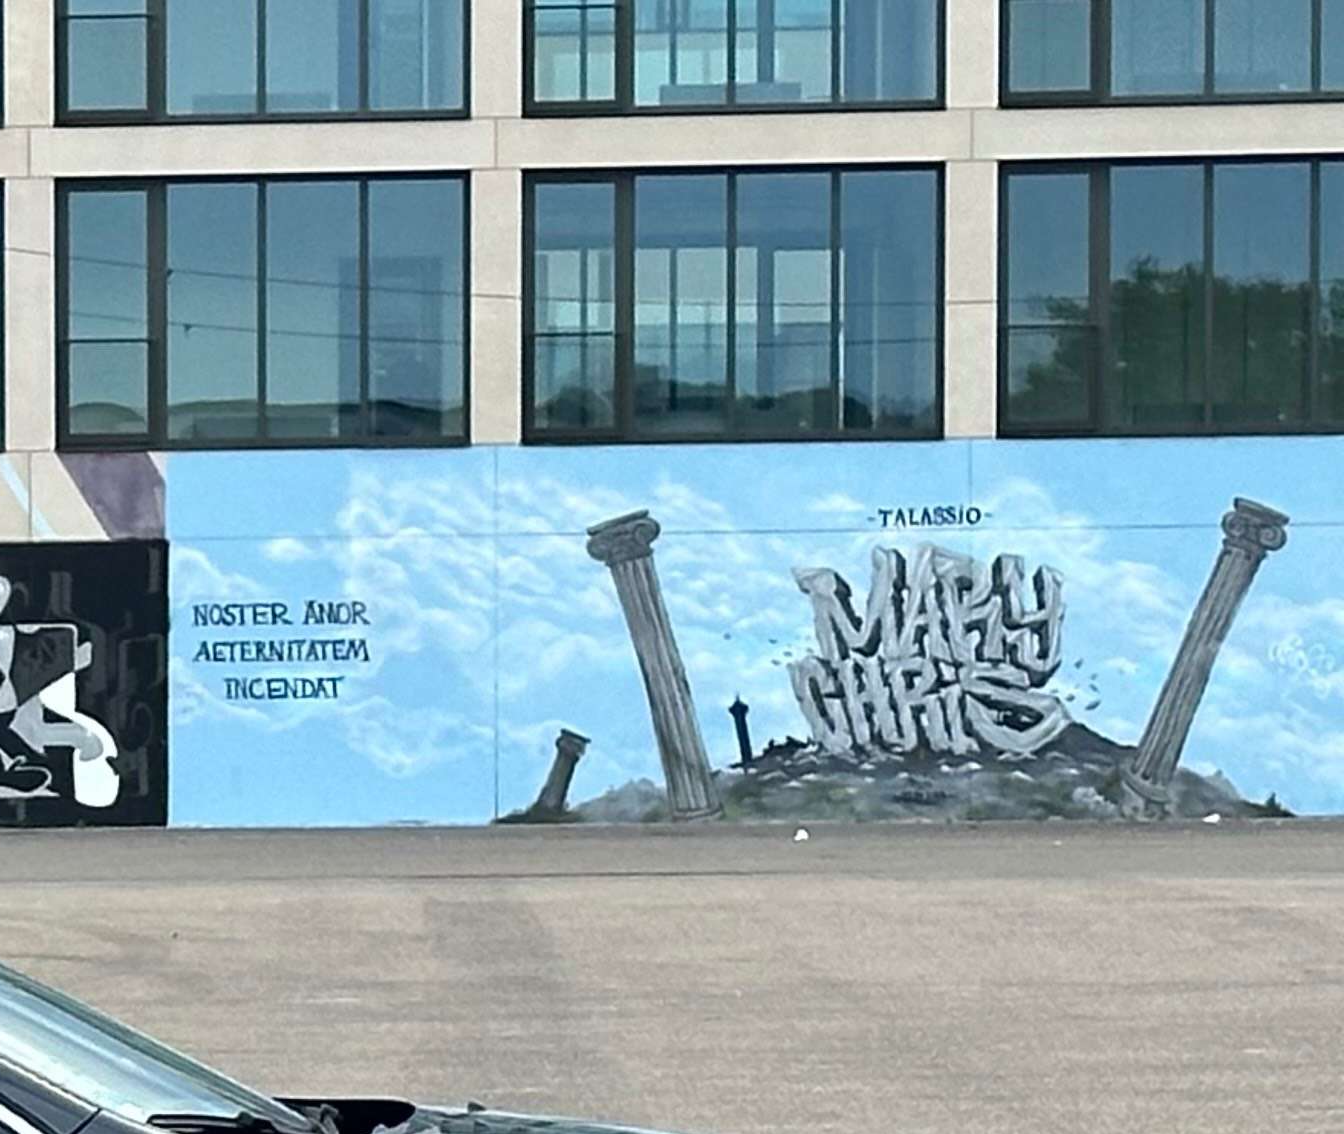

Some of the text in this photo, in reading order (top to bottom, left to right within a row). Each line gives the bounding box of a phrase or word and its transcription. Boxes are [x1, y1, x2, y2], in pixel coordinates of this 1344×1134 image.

[193, 601, 370, 626] NOSTER AMOR
[790, 543, 1065, 687] MARY
[193, 639, 370, 662] AETERNITATEM
[225, 677, 345, 699] INCENDAT
